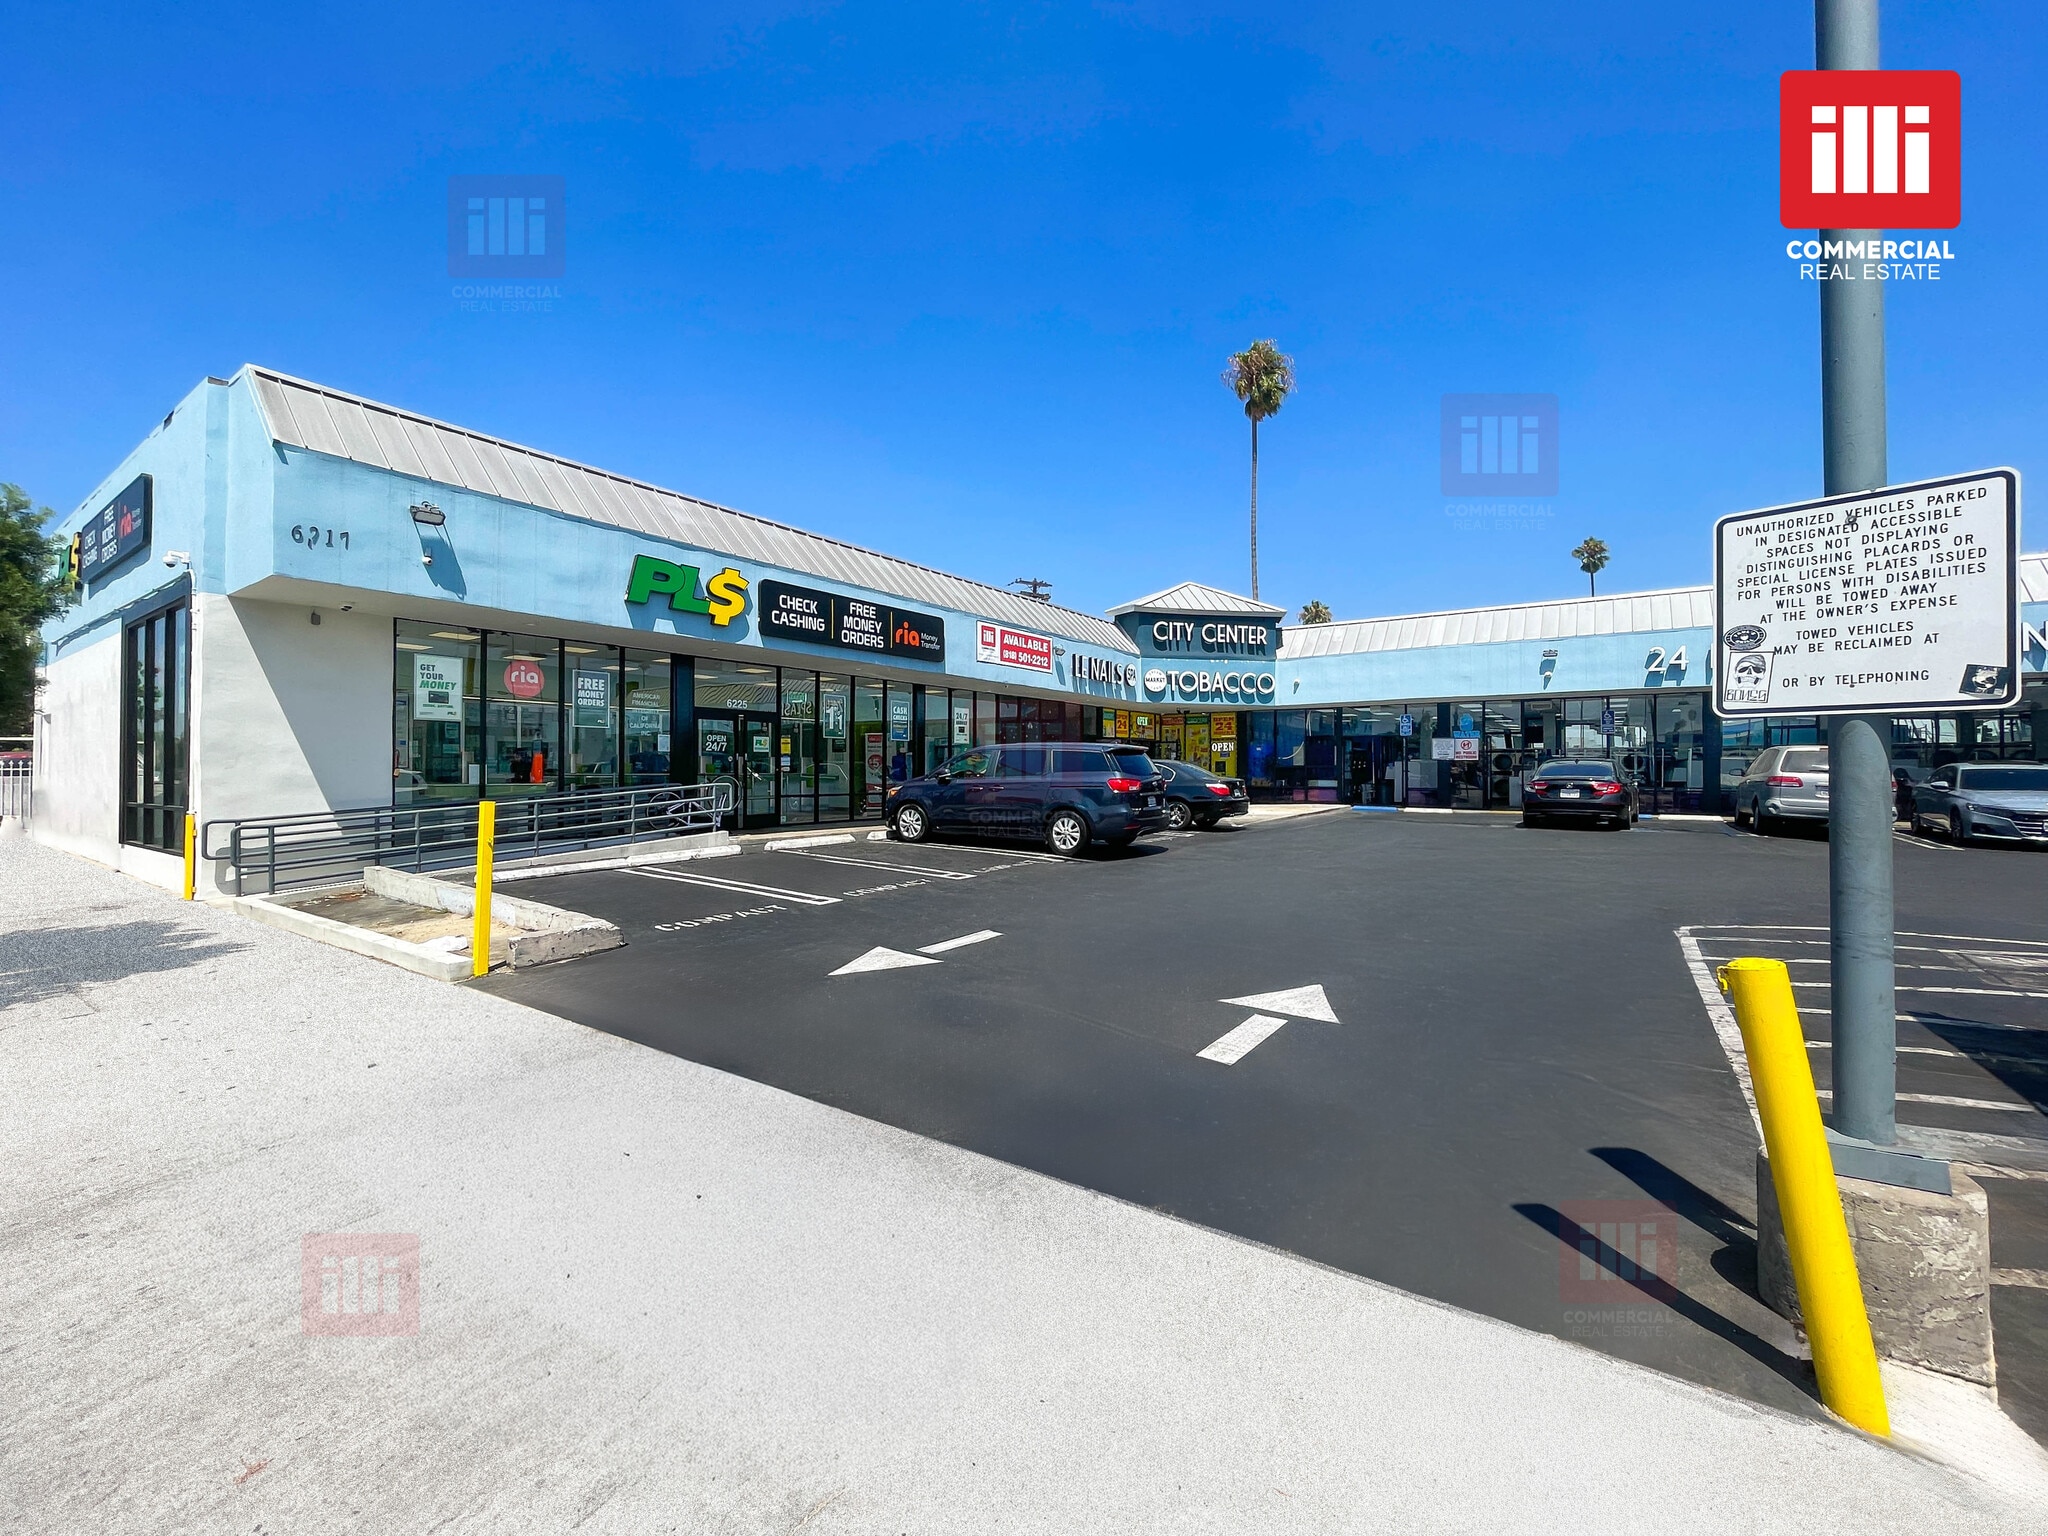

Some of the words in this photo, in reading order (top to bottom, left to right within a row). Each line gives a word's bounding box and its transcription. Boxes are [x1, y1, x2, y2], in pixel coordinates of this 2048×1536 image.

[1736, 512, 1834, 537] UNAUTHORIZED
[1845, 499, 1915, 518] VEHICLES
[1927, 487, 1987, 506] PARKED
[1755, 536, 1768, 547] IN
[1778, 522, 1859, 543] DESIGNATED
[1870, 506, 1962, 529] ACCESSIBLE
[1766, 543, 1814, 558] SPACES
[1825, 537, 1850, 550] NOT
[1861, 523, 1949, 545] DISPLAYING
[1746, 551, 1852, 574] DISTINGUISHING
[1864, 538, 1941, 558] PLACARDS
[1953, 534, 1974, 547] OR
[1737, 573, 1789, 588] SPECIAL
[1799, 564, 1855, 581] LICENSE
[1866, 556, 1917, 572] PLATES
[1930, 547, 1987, 564] ISSUED
[1738, 589, 1761, 601] FOR
[1771, 581, 1831, 597] PERSONS
[1842, 575, 1874, 589] WITH
[1886, 562, 1986, 584] DISABILITIES
[778, 594, 818, 616] CHECK
[1776, 598, 1806, 609] WILL
[1816, 594, 1833, 605] BE
[1843, 588, 1888, 602] TOWED
[1900, 582, 1937, 596] AWAY
[849, 602, 877, 619] FREE
[1760, 614, 1773, 624] AT
[1782, 610, 1806, 622] THE
[1816, 603, 1879, 619] OWNER'S
[1890, 595, 1958, 612] EXPENSE
[771, 610, 826, 633] CASHING
[843, 615, 883, 634] MONEY
[1796, 627, 1837, 641] TOWED
[1848, 621, 1914, 636] VEHICLES
[841, 630, 884, 649] ORDERS
[895, 621, 920, 647] ria
[920, 633, 938, 645] Money
[1153, 620, 1194, 641] CITY
[1201, 623, 1268, 645] CENTER
[920, 640, 941, 651] Transfer
[1003, 633, 1049, 653] AVAILABLE
[1773, 644, 1798, 656] MAY
[1808, 642, 1825, 653] BE
[1835, 635, 1912, 651] RECLAIMED
[1924, 633, 1940, 644] AT
[420, 664, 436, 672] GET
[1018, 651, 1049, 667] 501-2212
[1645, 645, 1690, 672] 24
[420, 671, 444, 681] YOUR
[510, 665, 539, 684] ria
[1089, 656, 1123, 685] NAILS
[1126, 668, 1137, 680] SPA
[1782, 678, 1799, 688] OR
[1809, 676, 1825, 687] BY
[1835, 670, 1930, 686] TELEPHONING
[419, 680, 457, 690] MONEY
[577, 677, 605, 691] FREE
[1167, 670, 1276, 695] TOBACCO
[577, 689, 605, 699] MONEY
[577, 698, 605, 707] ORDERS
[726, 698, 748, 710] 6225
[893, 705, 908, 715] CASH
[955, 712, 968, 721] 24/7
[1117, 719, 1127, 730] 24
[1215, 721, 1233, 731] 24
[705, 741, 728, 752] 24/7
[706, 734, 727, 743] OPEN
[1211, 742, 1235, 752] OPEN
[654, 903, 787, 932] COMPACT
